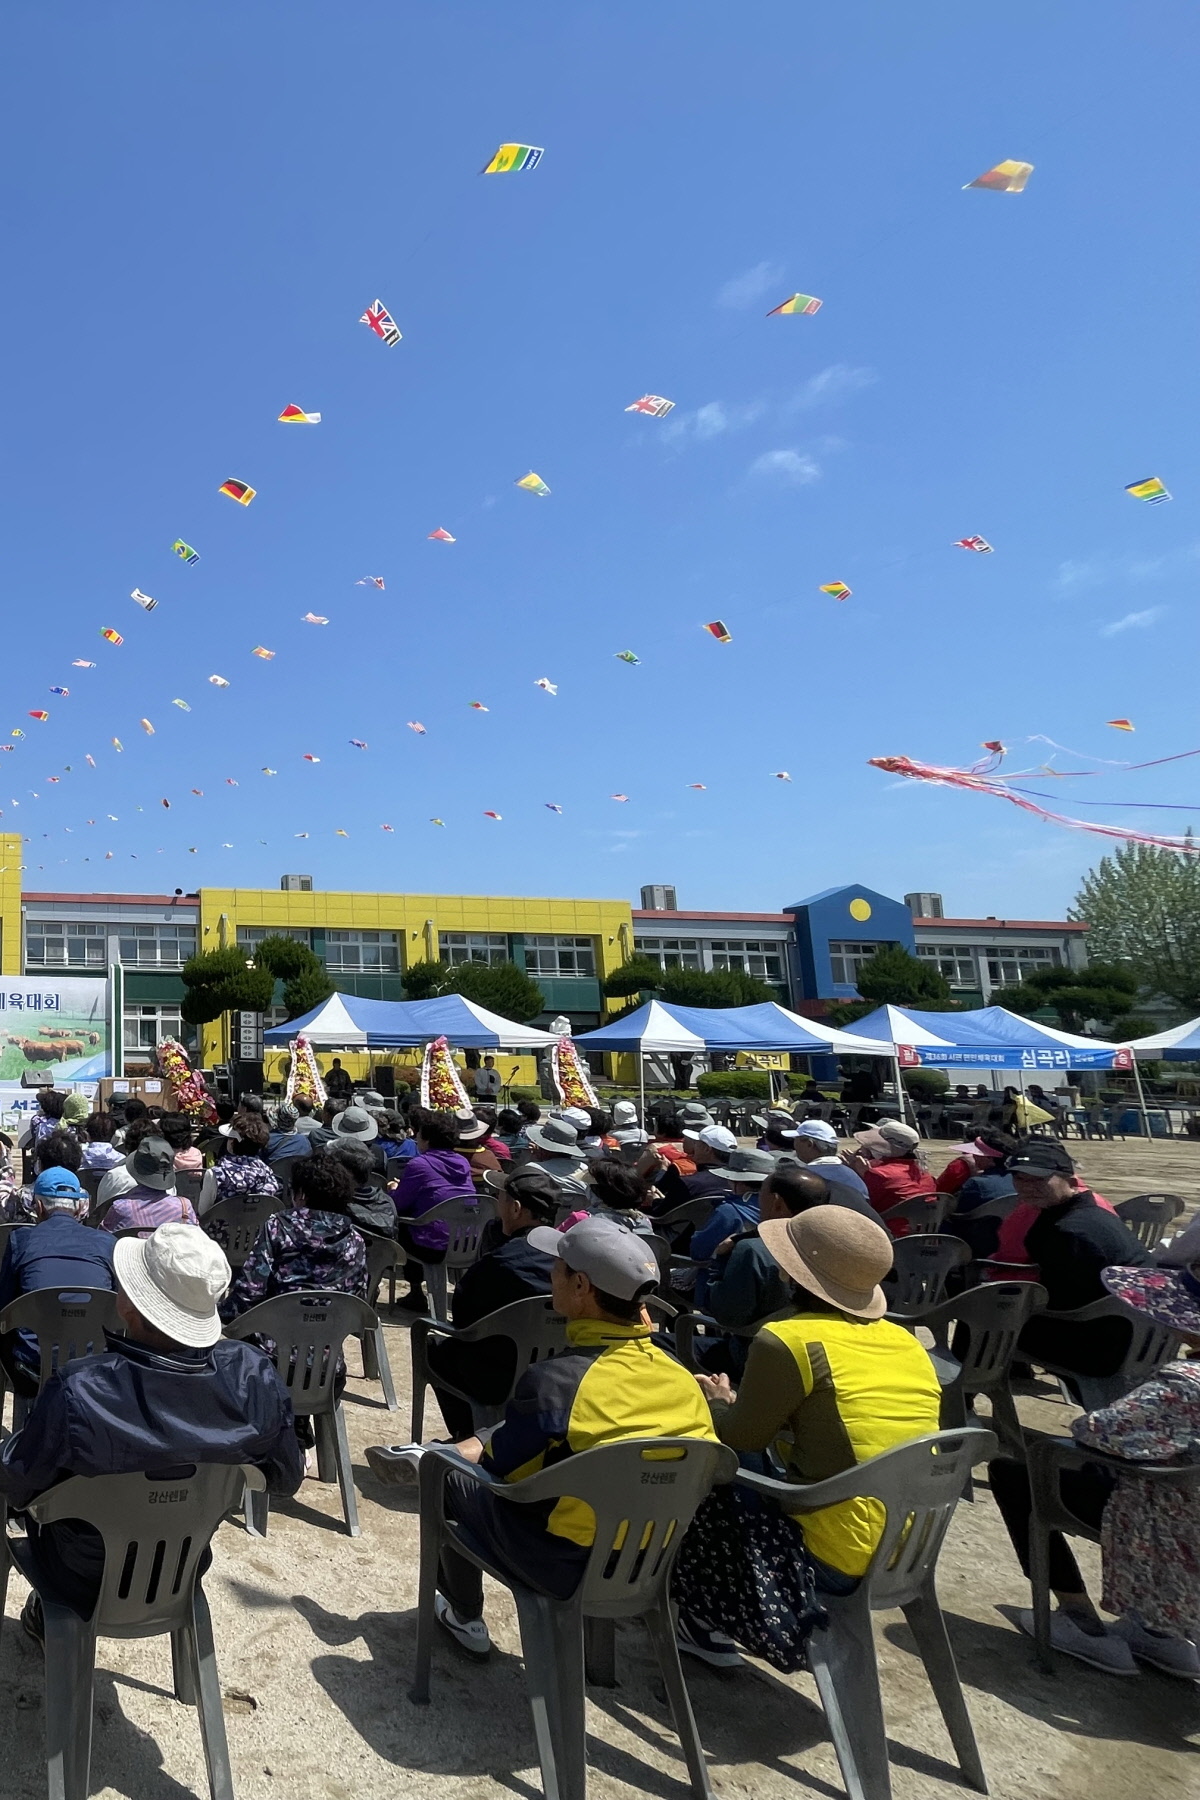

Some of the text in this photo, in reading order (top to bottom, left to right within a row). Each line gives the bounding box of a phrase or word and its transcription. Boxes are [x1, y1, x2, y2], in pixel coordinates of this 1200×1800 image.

[1021, 1049, 1071, 1069] 심곡리
[303, 1313, 328, 1322] 강산렌탈
[640, 1472, 677, 1485] 강산렌탈
[148, 1489, 189, 1504] 강산렌탈
